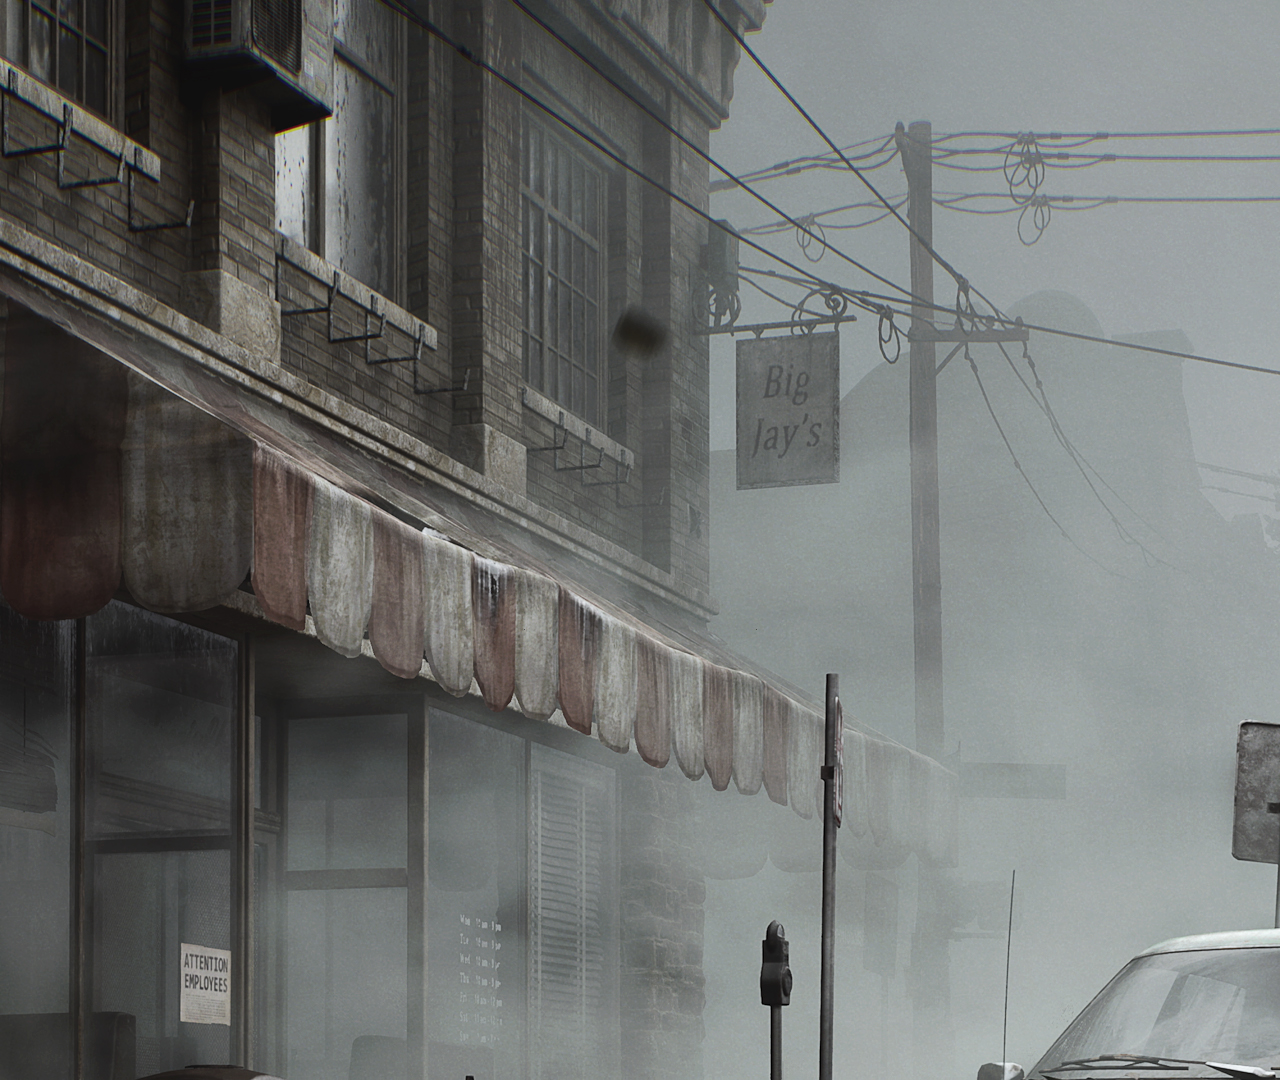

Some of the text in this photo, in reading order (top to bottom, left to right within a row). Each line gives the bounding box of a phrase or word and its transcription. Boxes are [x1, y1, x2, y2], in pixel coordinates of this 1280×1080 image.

[763, 364, 810, 406] Big
[751, 413, 822, 459] Jay's
[184, 953, 229, 973] ATTENTION
[184, 973, 228, 993] EMPLOYEES
